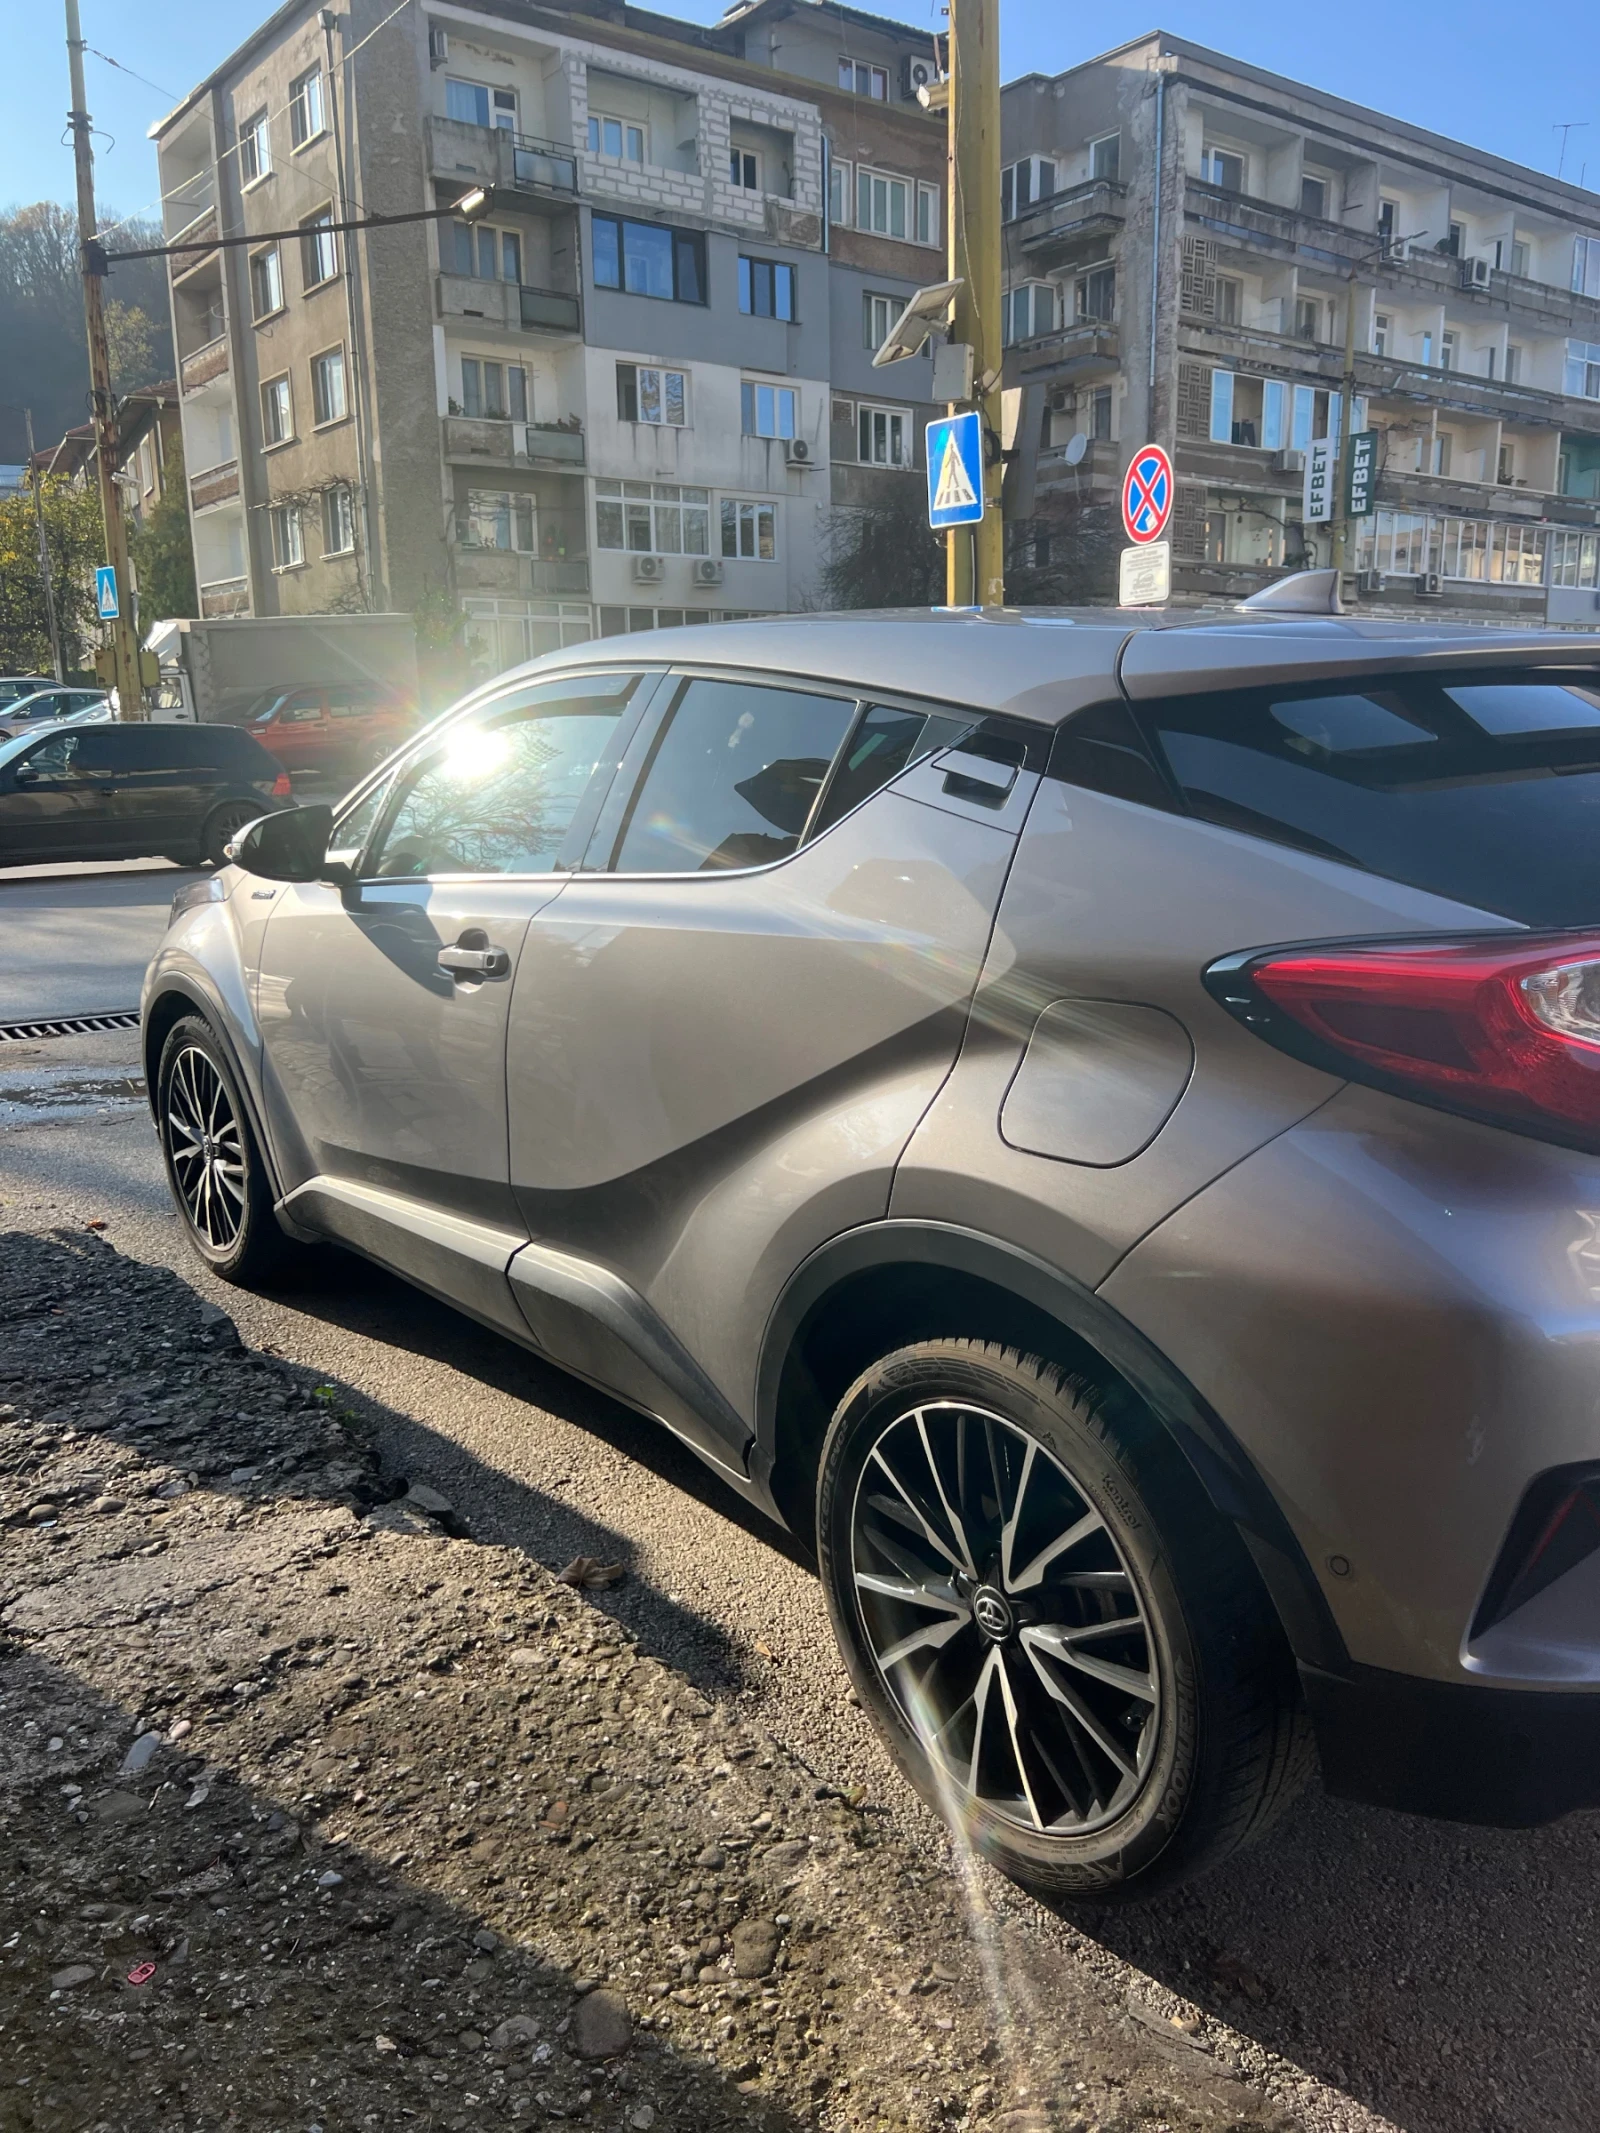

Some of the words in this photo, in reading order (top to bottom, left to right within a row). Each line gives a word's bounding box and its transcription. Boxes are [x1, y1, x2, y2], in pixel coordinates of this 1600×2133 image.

[1310, 446, 1328, 517] EFBET
[1351, 439, 1371, 513] EFBET
[1156, 1680, 1196, 1834] Hankook
